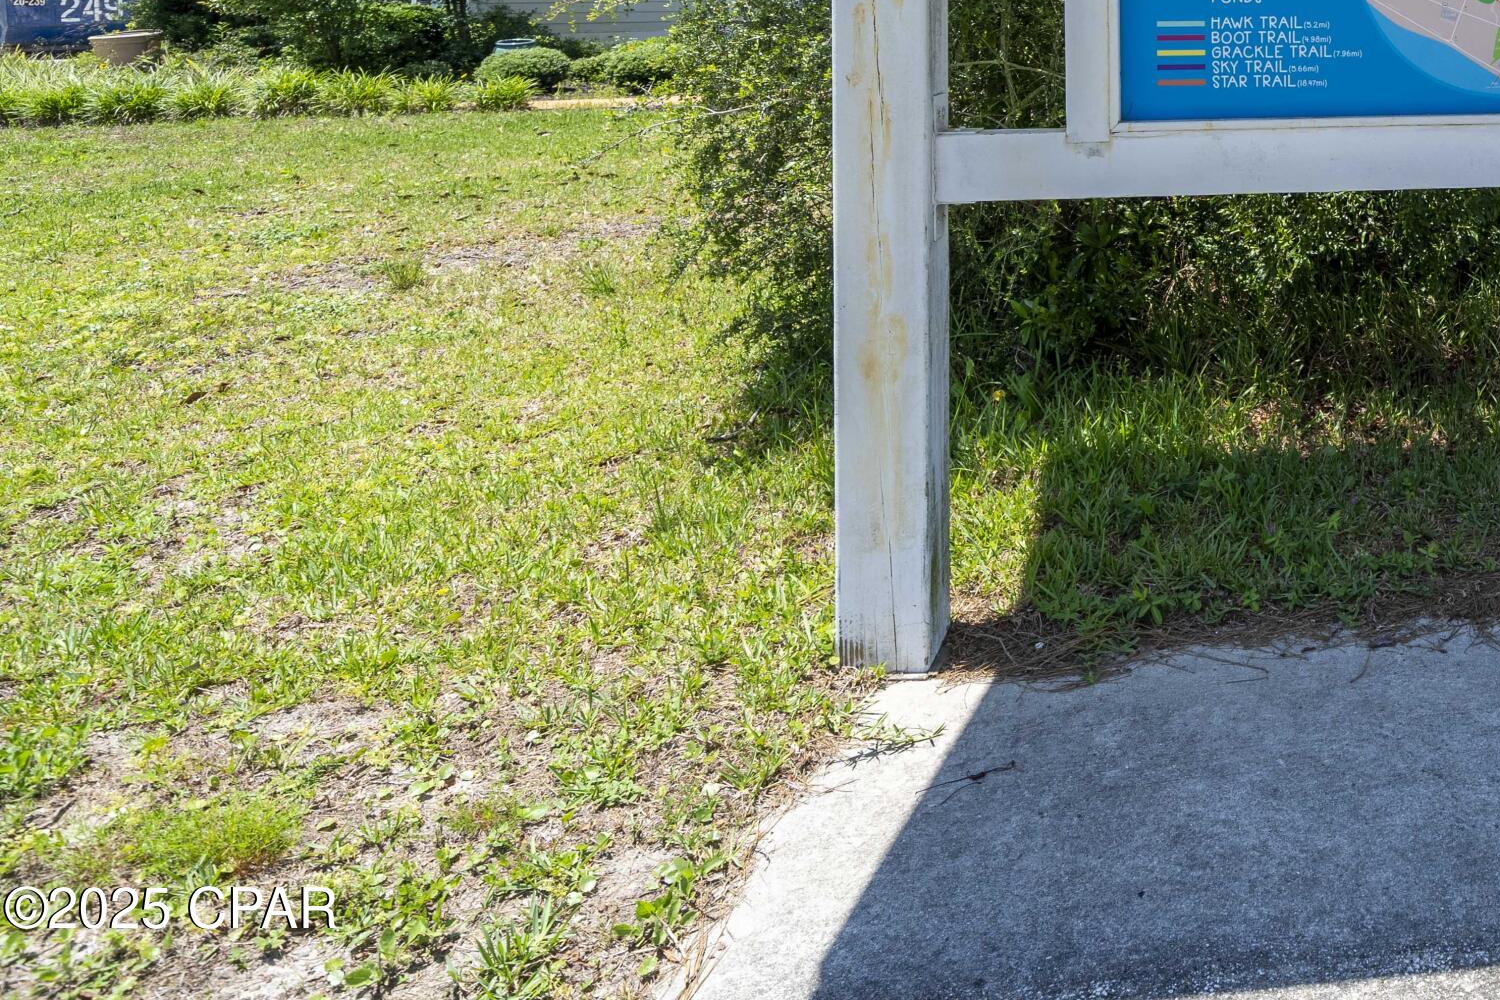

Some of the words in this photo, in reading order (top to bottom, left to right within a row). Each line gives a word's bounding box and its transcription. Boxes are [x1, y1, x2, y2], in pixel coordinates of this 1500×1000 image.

[1211, 16, 1253, 29] HAWK
[1260, 16, 1303, 29] TRAIL
[1211, 31, 1252, 44] BOOT
[1258, 31, 1301, 44] TRAIL
[1211, 45, 1284, 59] GRACKLE
[1290, 45, 1332, 58] TRAIL
[1212, 60, 1239, 74] SKY
[1245, 60, 1288, 73] TRAIL
[1212, 75, 1247, 89] STAR
[1253, 75, 1296, 88] TRAIL
